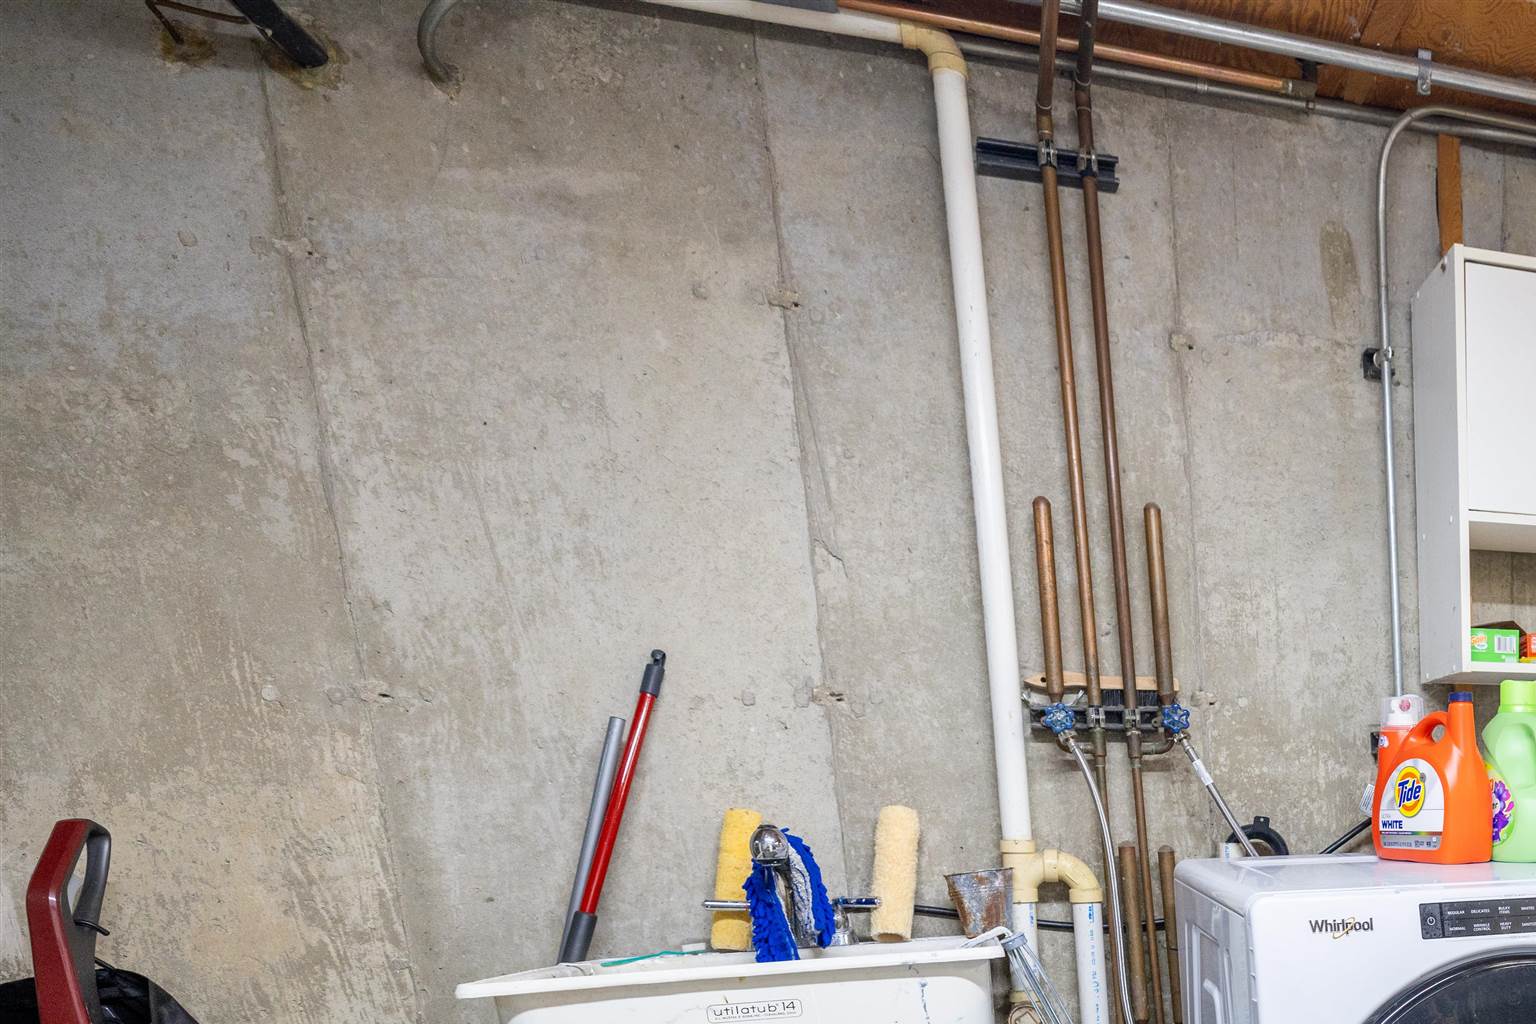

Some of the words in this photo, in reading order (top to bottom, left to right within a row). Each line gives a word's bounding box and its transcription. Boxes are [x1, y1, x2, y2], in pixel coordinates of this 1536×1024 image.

[1398, 779, 1422, 807] Tide
[1381, 820, 1403, 829] WHITE
[1309, 917, 1374, 936] Whirlpool
[782, 1001, 796, 1011] 14
